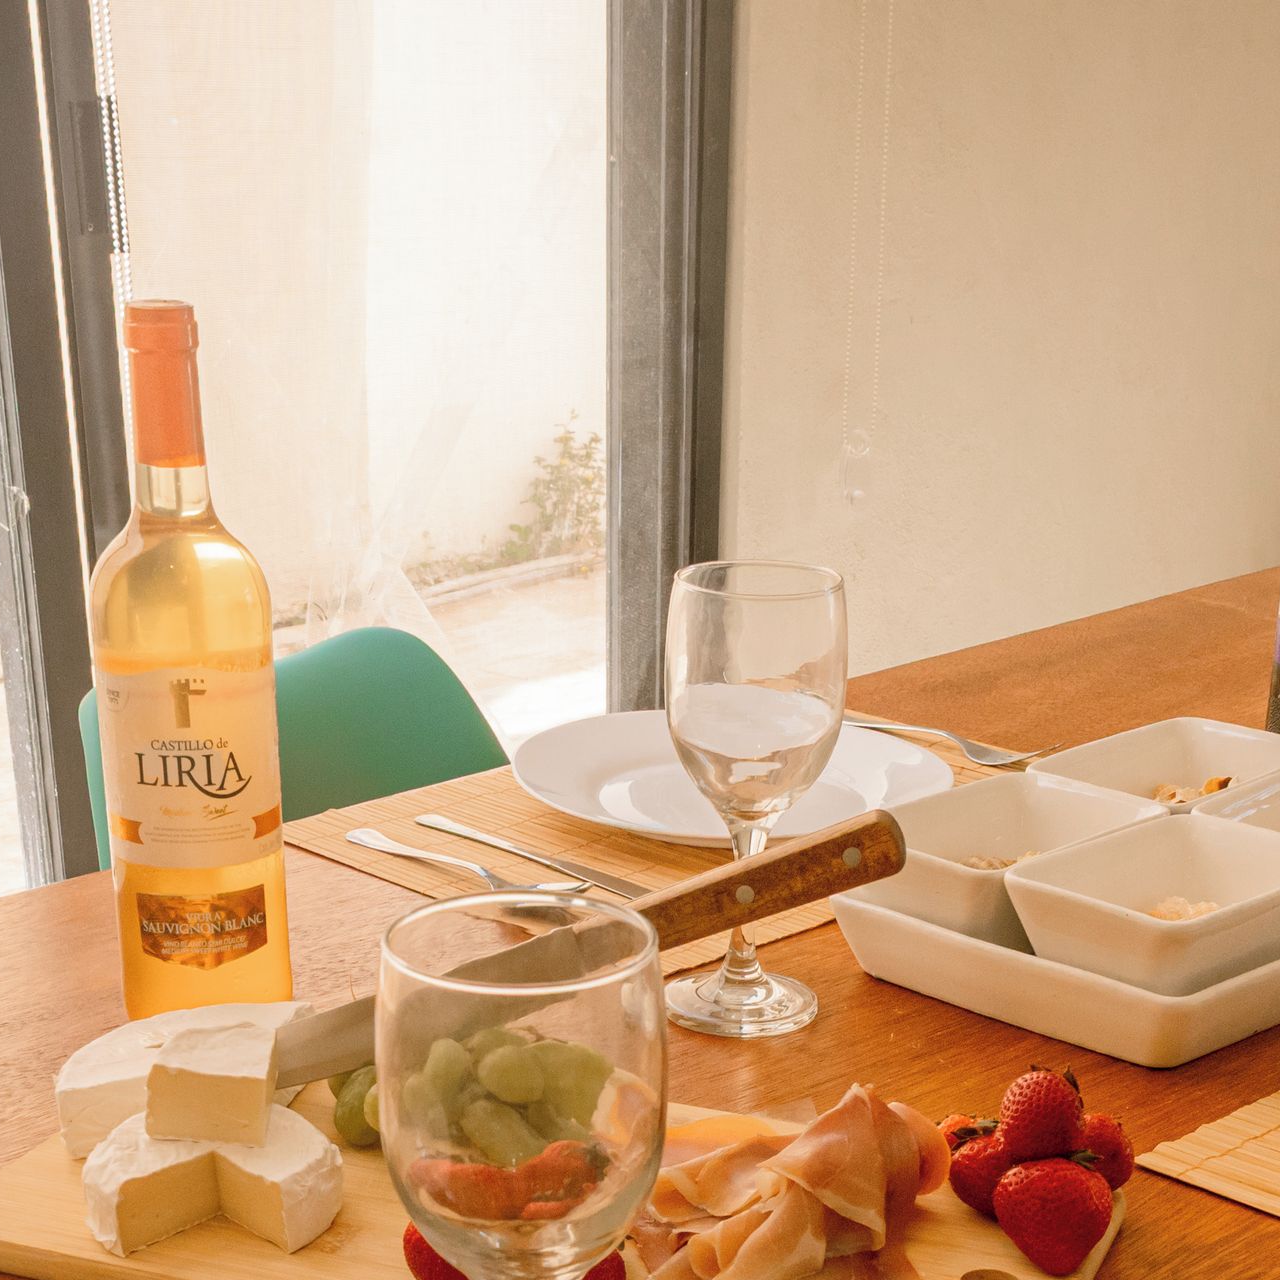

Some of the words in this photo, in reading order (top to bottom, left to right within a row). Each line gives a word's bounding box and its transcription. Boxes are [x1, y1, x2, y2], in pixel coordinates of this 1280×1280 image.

[150, 739, 214, 751] CASTILLO
[216, 738, 229, 749] de
[134, 751, 252, 799] LIRIA
[142, 920, 222, 935] SAUVIGNON
[224, 912, 264, 931] BLANC
